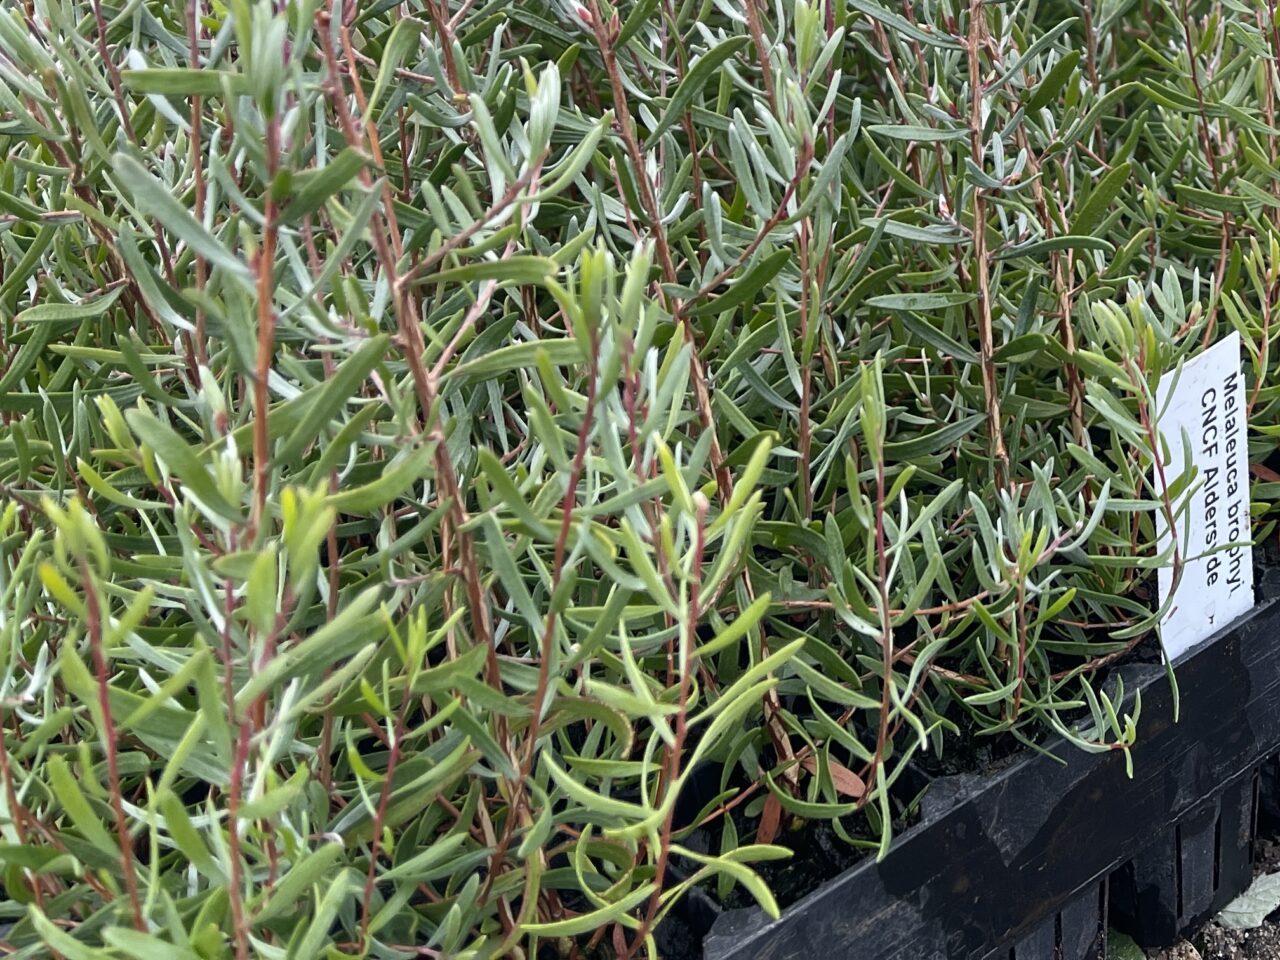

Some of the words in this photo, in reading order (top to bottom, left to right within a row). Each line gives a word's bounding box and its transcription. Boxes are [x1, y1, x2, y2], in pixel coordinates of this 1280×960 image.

[1200, 387, 1219, 458] CNCF
[1223, 371, 1240, 497] Melaleuca
[1226, 500, 1245, 593] brophyi
